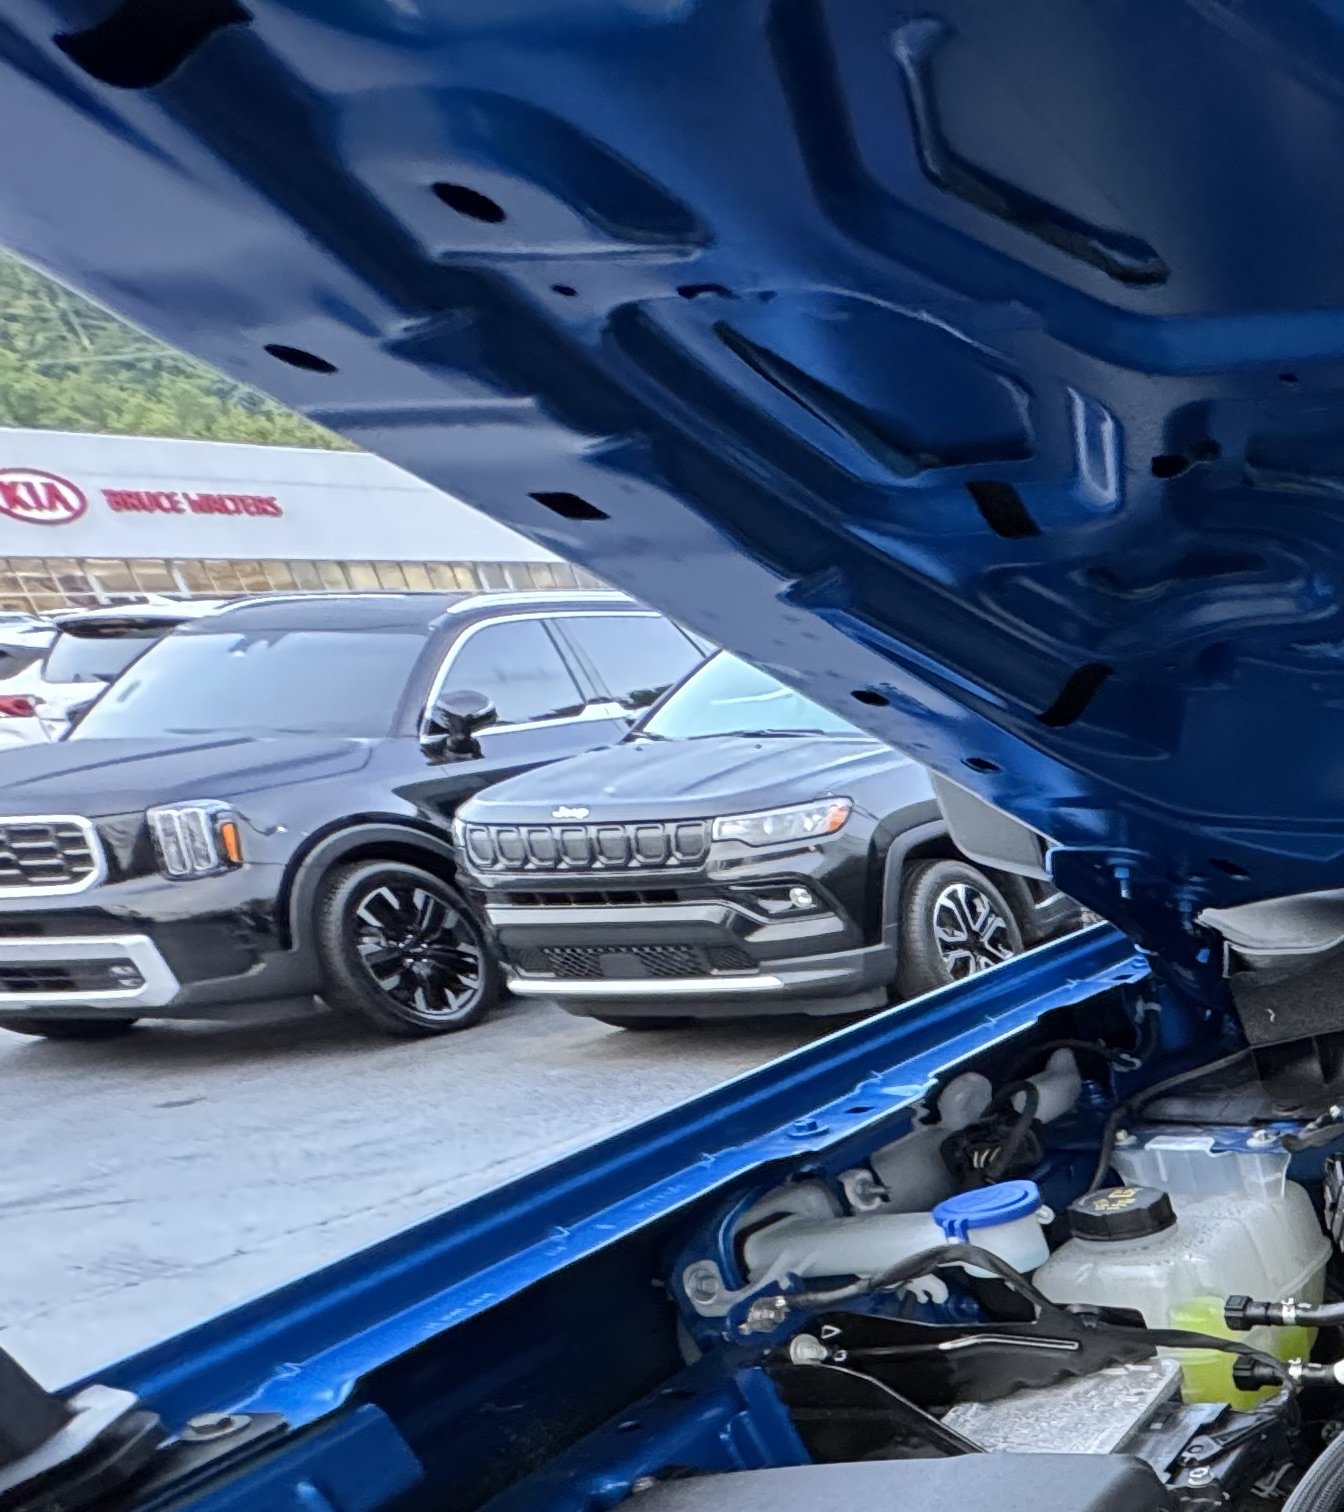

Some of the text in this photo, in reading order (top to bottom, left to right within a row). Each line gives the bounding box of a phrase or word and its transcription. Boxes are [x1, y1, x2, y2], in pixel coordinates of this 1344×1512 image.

[0, 481, 74, 512] KIA
[101, 489, 284, 518] BRUCE WALTERS
